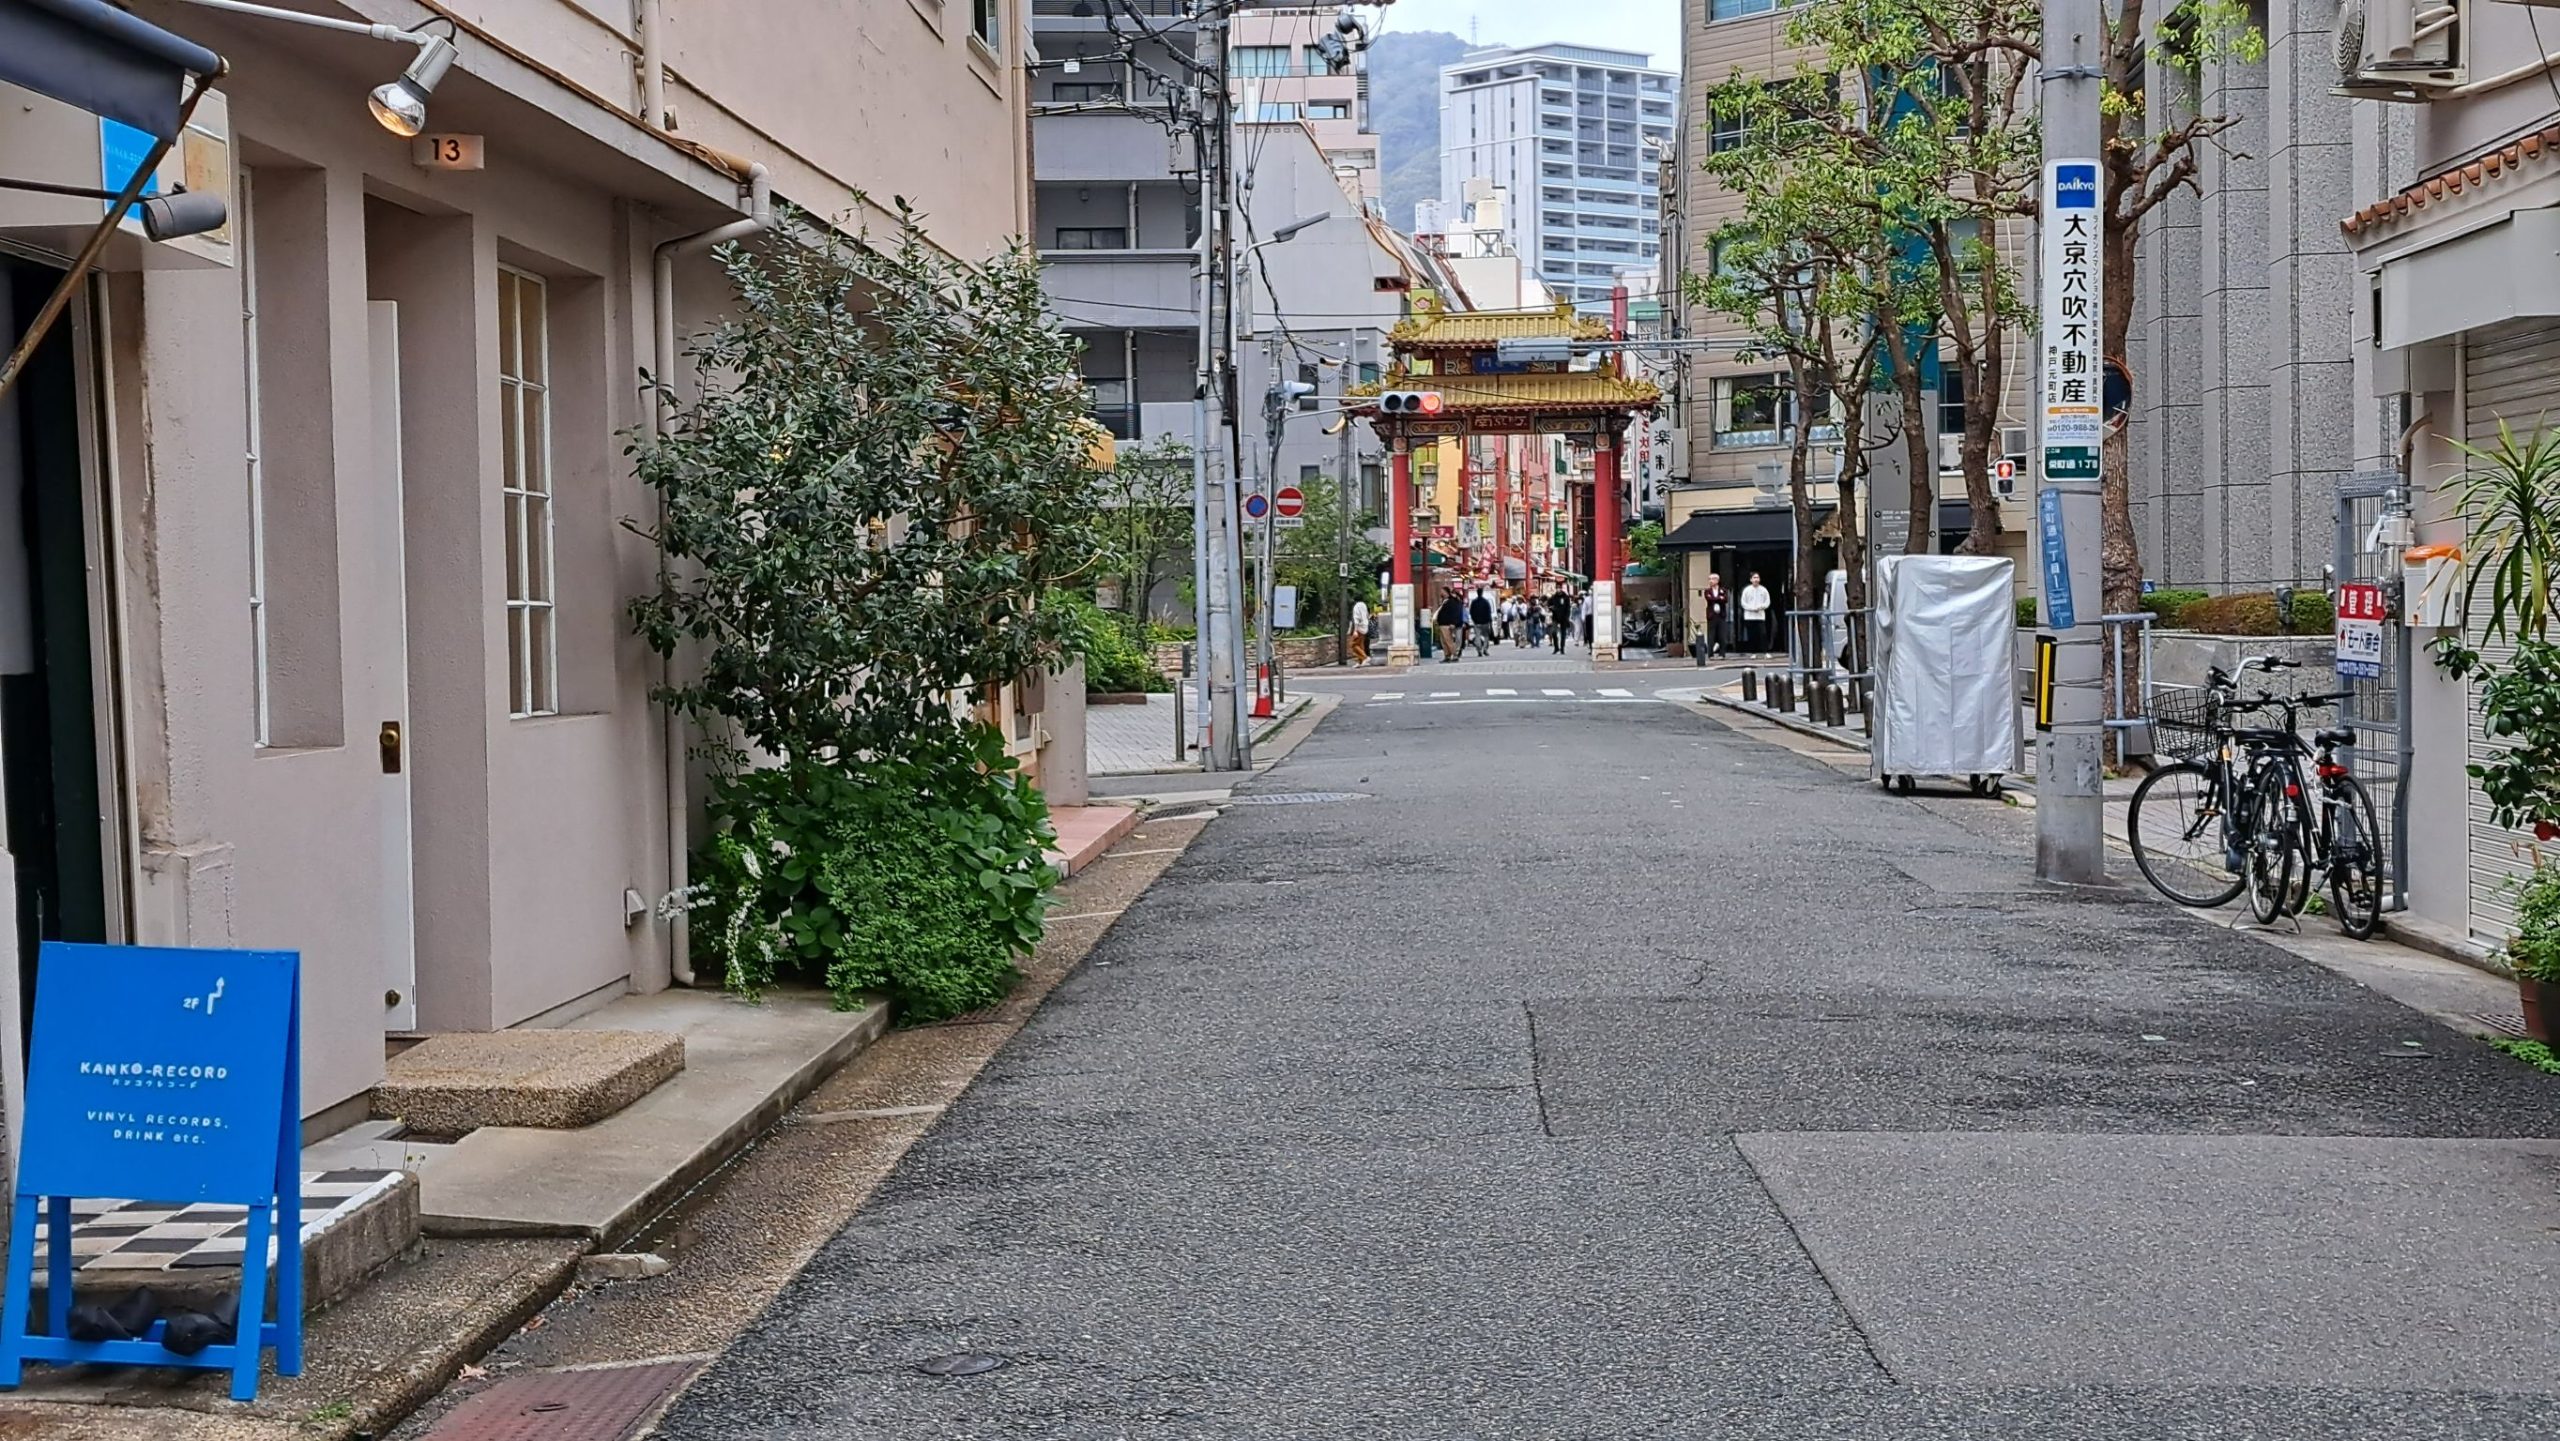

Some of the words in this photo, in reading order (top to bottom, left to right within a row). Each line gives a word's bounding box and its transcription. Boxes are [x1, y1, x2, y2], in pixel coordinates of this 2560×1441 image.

[431, 138, 461, 162] 13
[2061, 213, 2088, 403] 大京穴吹不動産
[2048, 345, 2058, 403] 神戸元町店
[182, 997, 200, 1010] 2F
[87, 1110, 136, 1123] VINYL
[113, 1128, 165, 1142] DRINK
[173, 1133, 206, 1145] etc.
